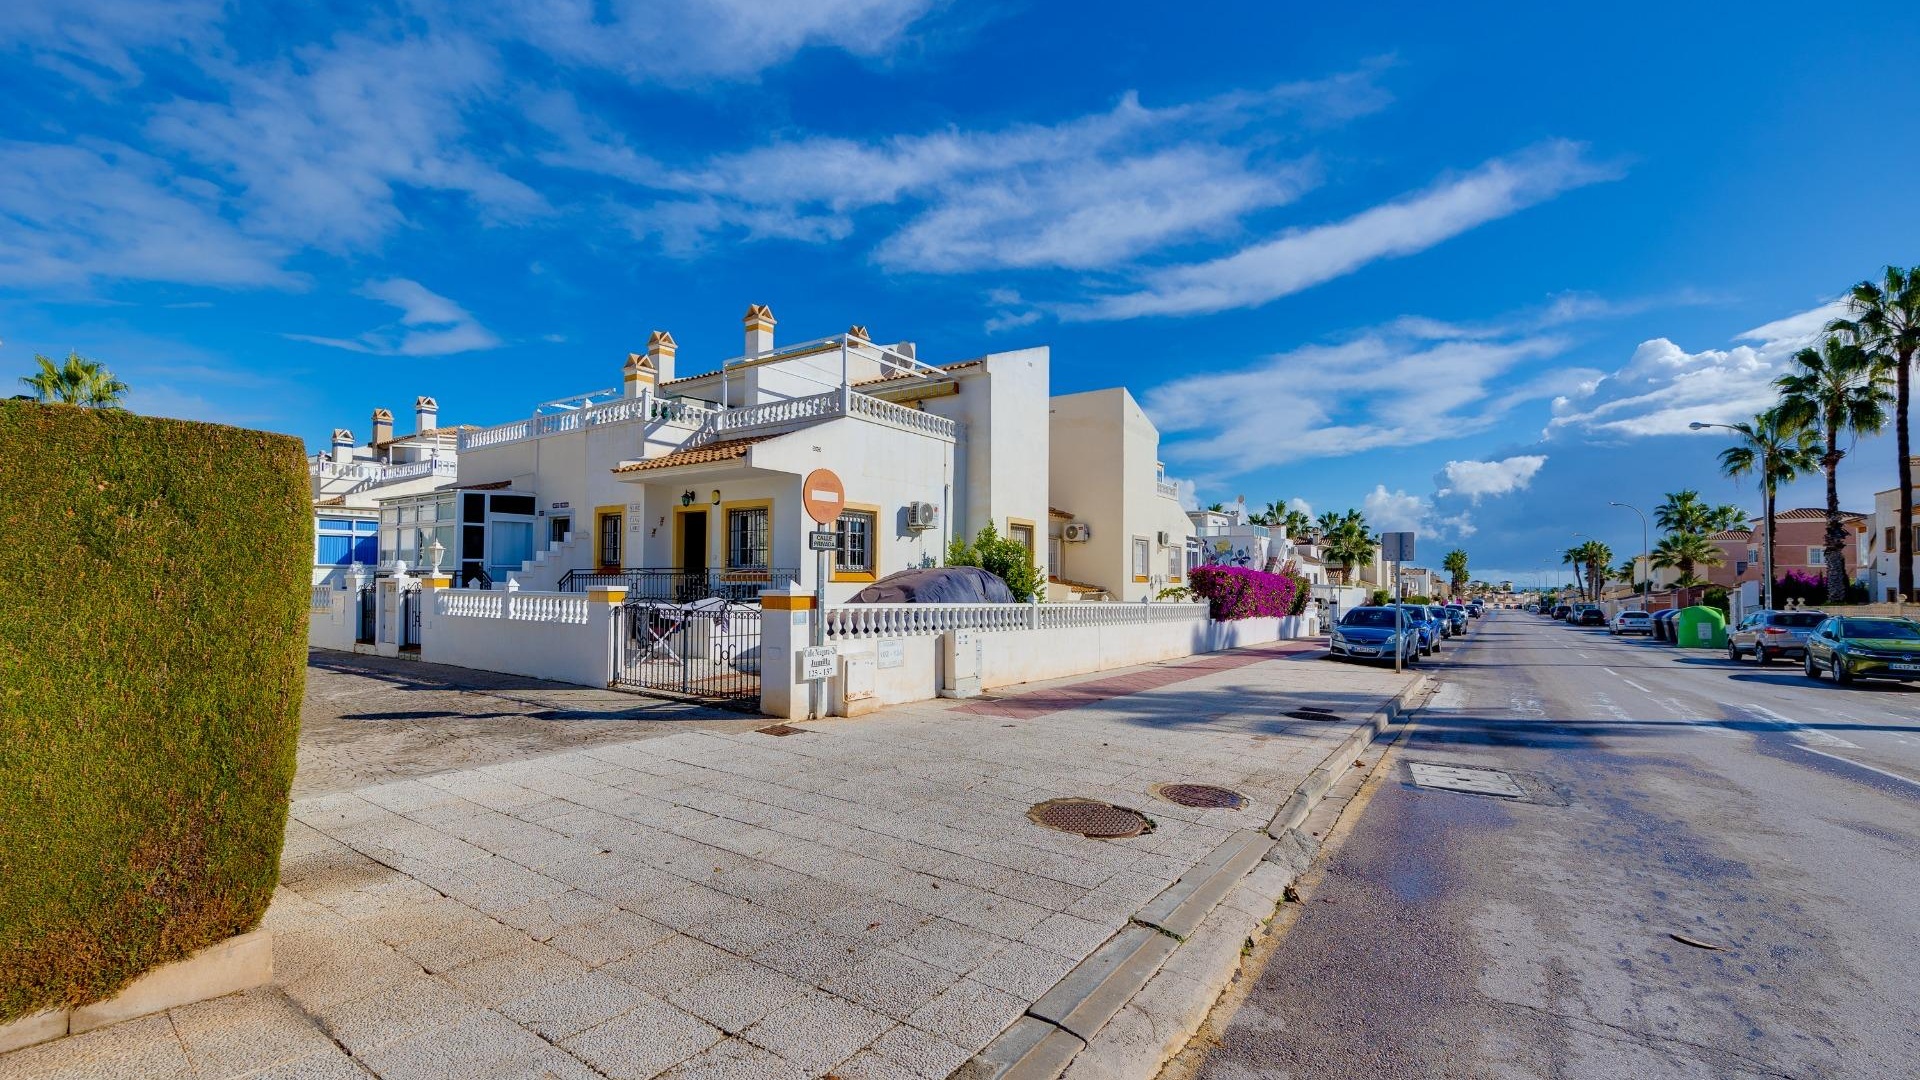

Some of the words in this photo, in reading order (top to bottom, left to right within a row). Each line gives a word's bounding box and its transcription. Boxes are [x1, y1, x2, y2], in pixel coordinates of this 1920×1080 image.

[811, 658, 831, 667] Jumilla
[808, 669, 818, 677] 125
[823, 667, 833, 676] 137
